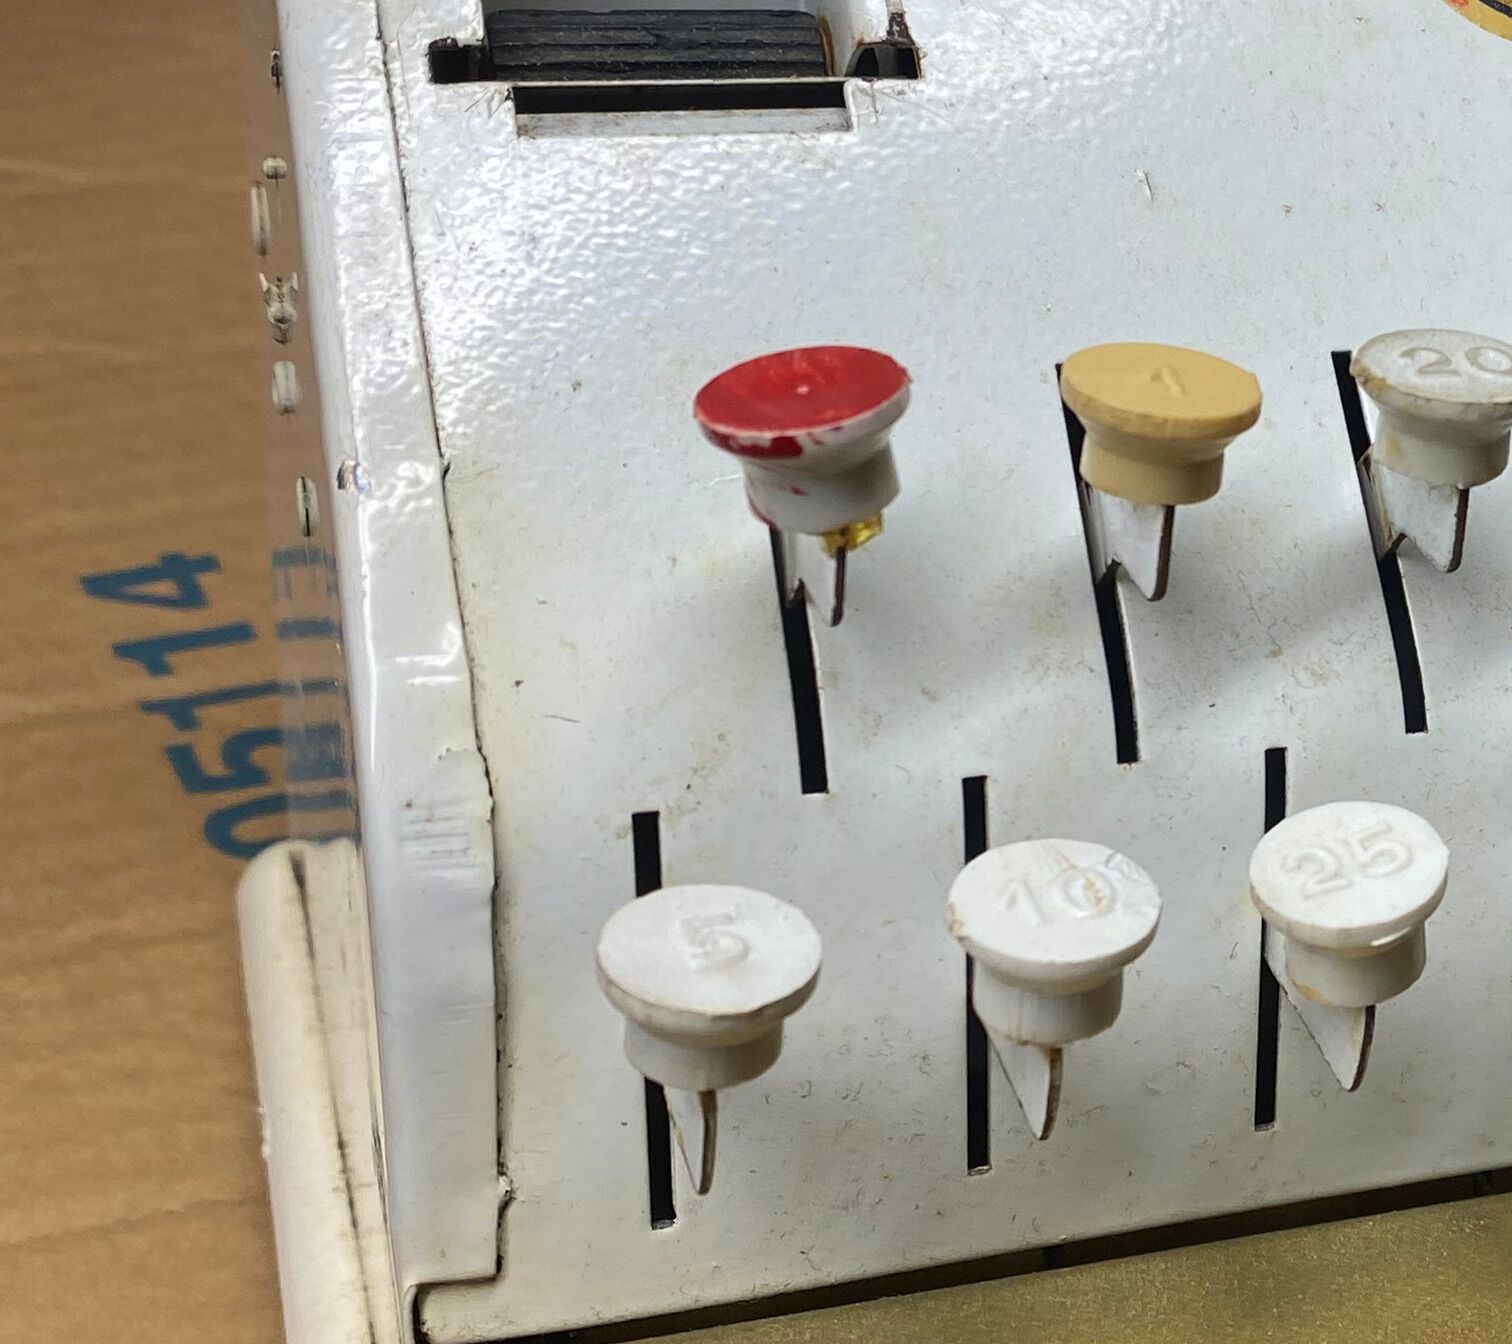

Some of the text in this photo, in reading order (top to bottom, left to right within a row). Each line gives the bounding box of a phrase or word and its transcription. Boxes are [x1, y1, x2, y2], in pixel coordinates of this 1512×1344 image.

[1145, 363, 1187, 400] 1
[79, 551, 290, 860] 05114
[1280, 820, 1414, 901] 25
[996, 865, 1118, 928] 10
[676, 912, 752, 971] 5
